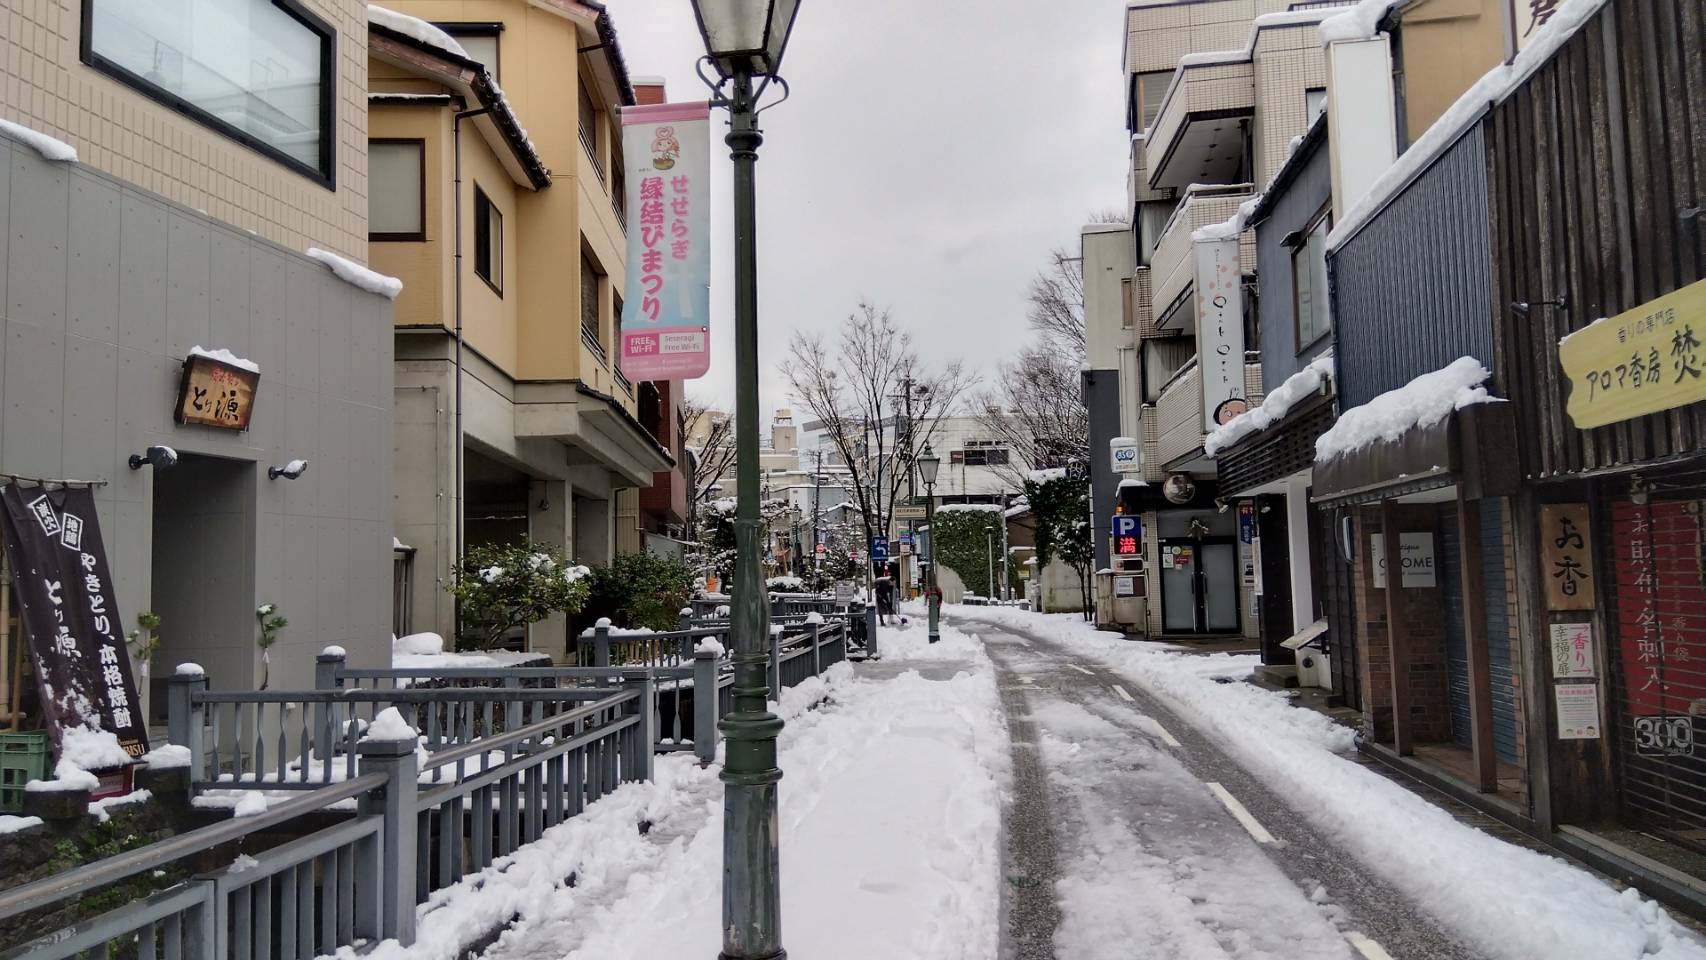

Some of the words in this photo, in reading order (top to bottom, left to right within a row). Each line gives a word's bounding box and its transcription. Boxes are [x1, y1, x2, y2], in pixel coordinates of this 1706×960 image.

[670, 174, 689, 260] せせらぎ
[640, 176, 664, 321] 縁結びまつり
[631, 336, 651, 346] FREE
[631, 345, 652, 354] Wi-Fi
[1586, 347, 1661, 402] アロマ香房
[1120, 518, 1134, 535] P
[1120, 537, 1136, 554] 満
[1553, 516, 1590, 596] お香
[1570, 632, 1589, 668] 香り
[1636, 719, 1691, 749] 300
